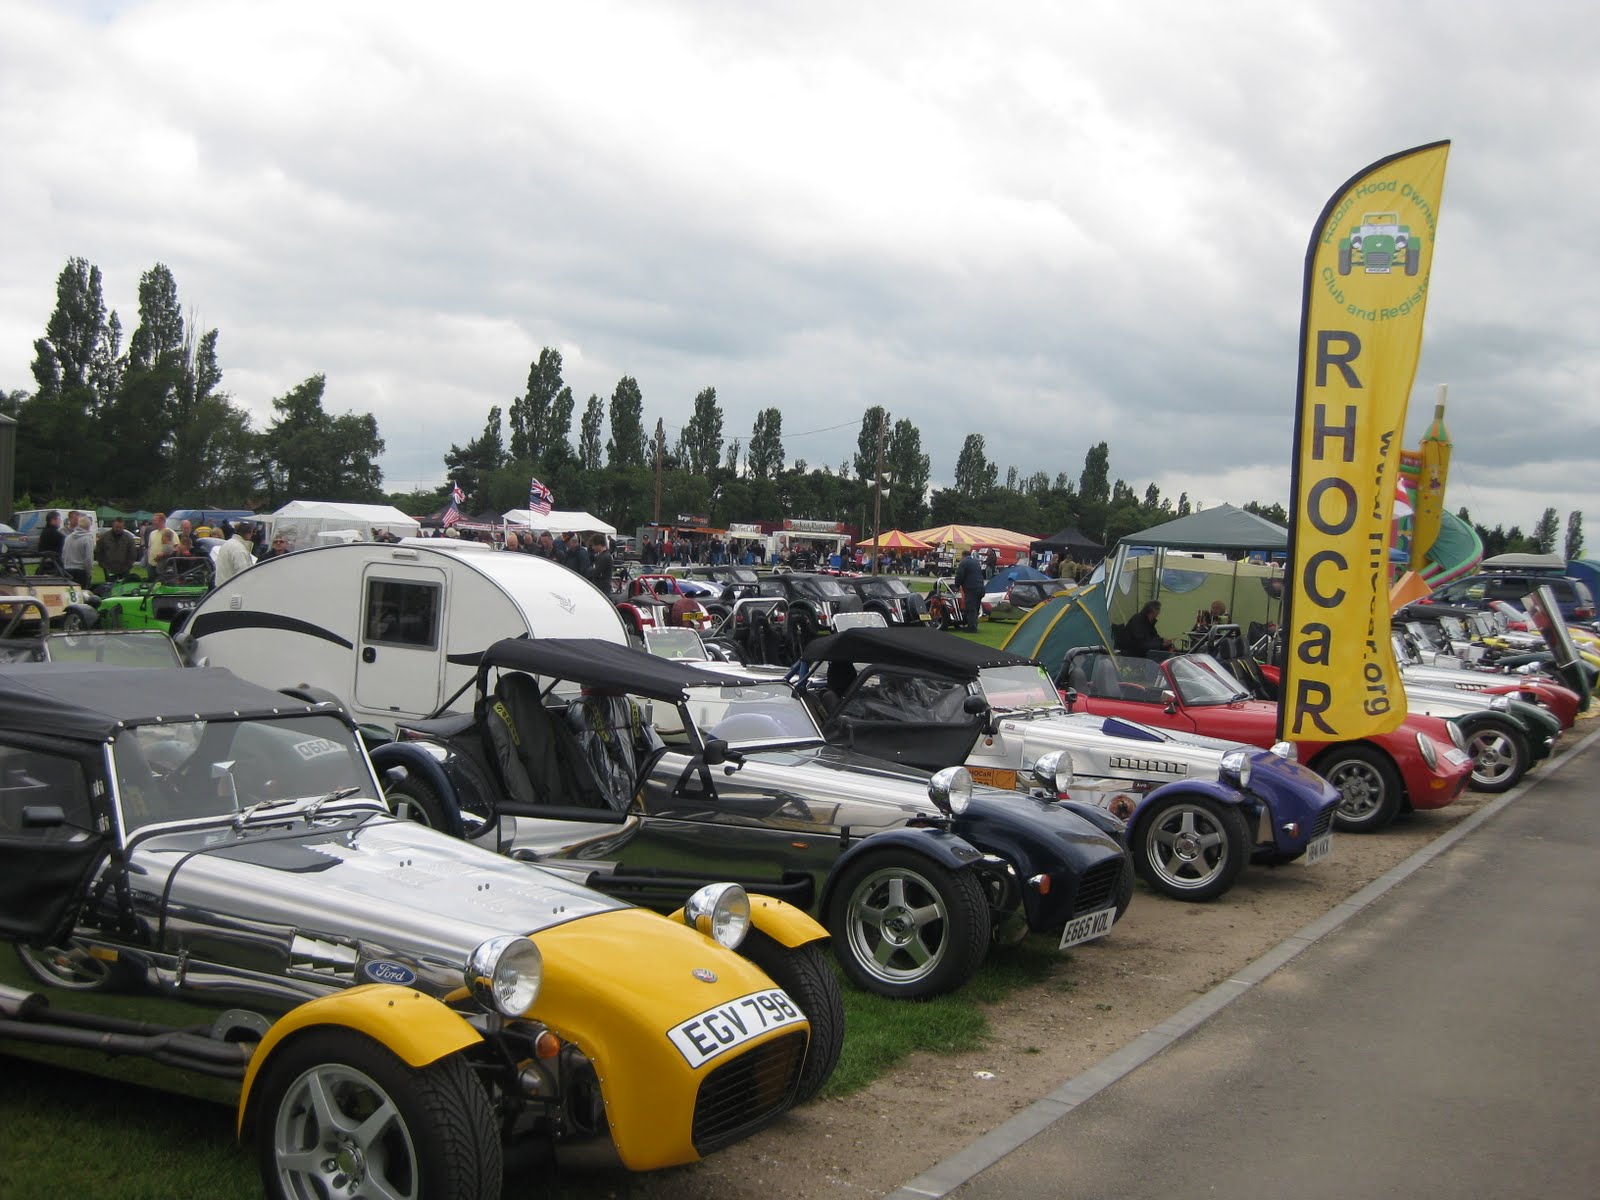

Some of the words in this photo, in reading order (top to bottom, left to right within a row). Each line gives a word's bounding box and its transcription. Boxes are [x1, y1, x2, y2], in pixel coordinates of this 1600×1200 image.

[1355, 180, 1397, 199] Hood
[1322, 266, 1345, 305] Club
[1346, 303, 1377, 321] and
[1064, 916, 1093, 943] E665
[375, 963, 406, 981] Ford
[682, 1006, 748, 1057] EGV
[741, 991, 798, 1027] 798
